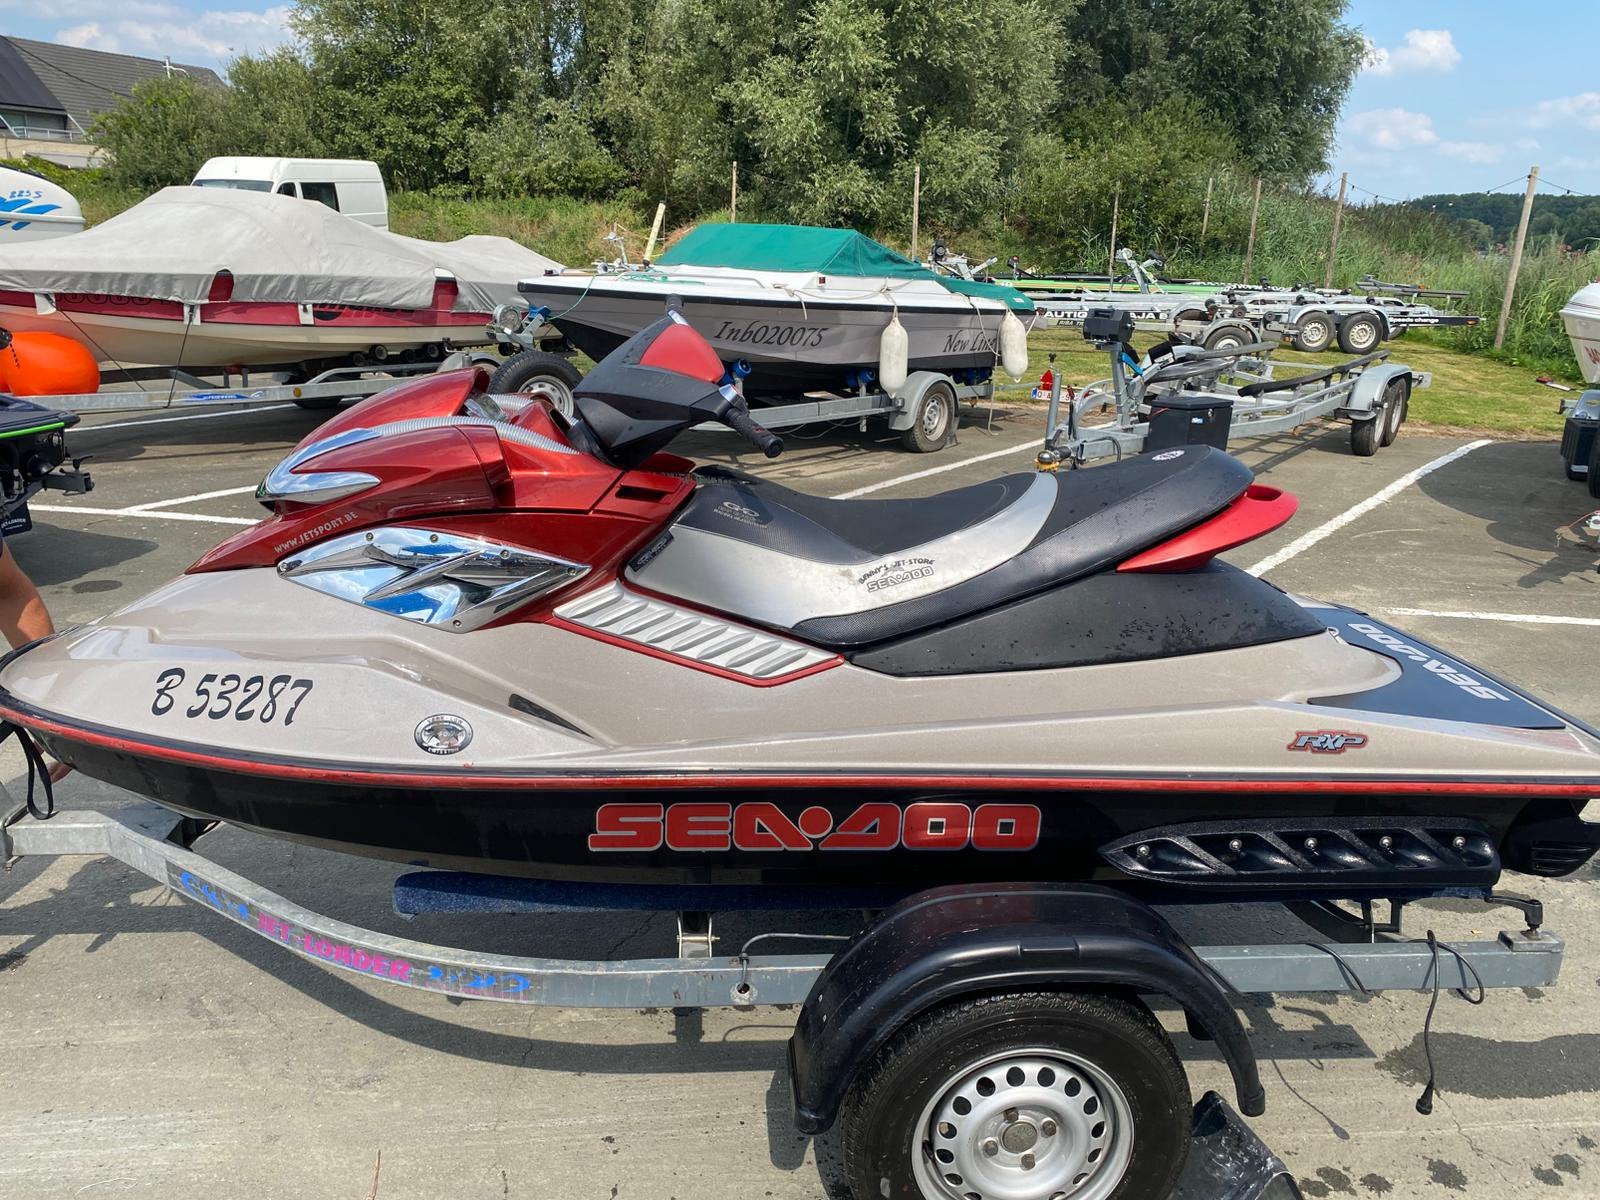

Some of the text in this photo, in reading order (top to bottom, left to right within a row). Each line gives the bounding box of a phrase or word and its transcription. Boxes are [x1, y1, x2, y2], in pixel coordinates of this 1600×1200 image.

[942, 329, 970, 353] New
[274, 511, 359, 553] WWW.JETSPORT.BE
[151, 667, 314, 727] B 53287
[1287, 729, 1369, 755] RXP
